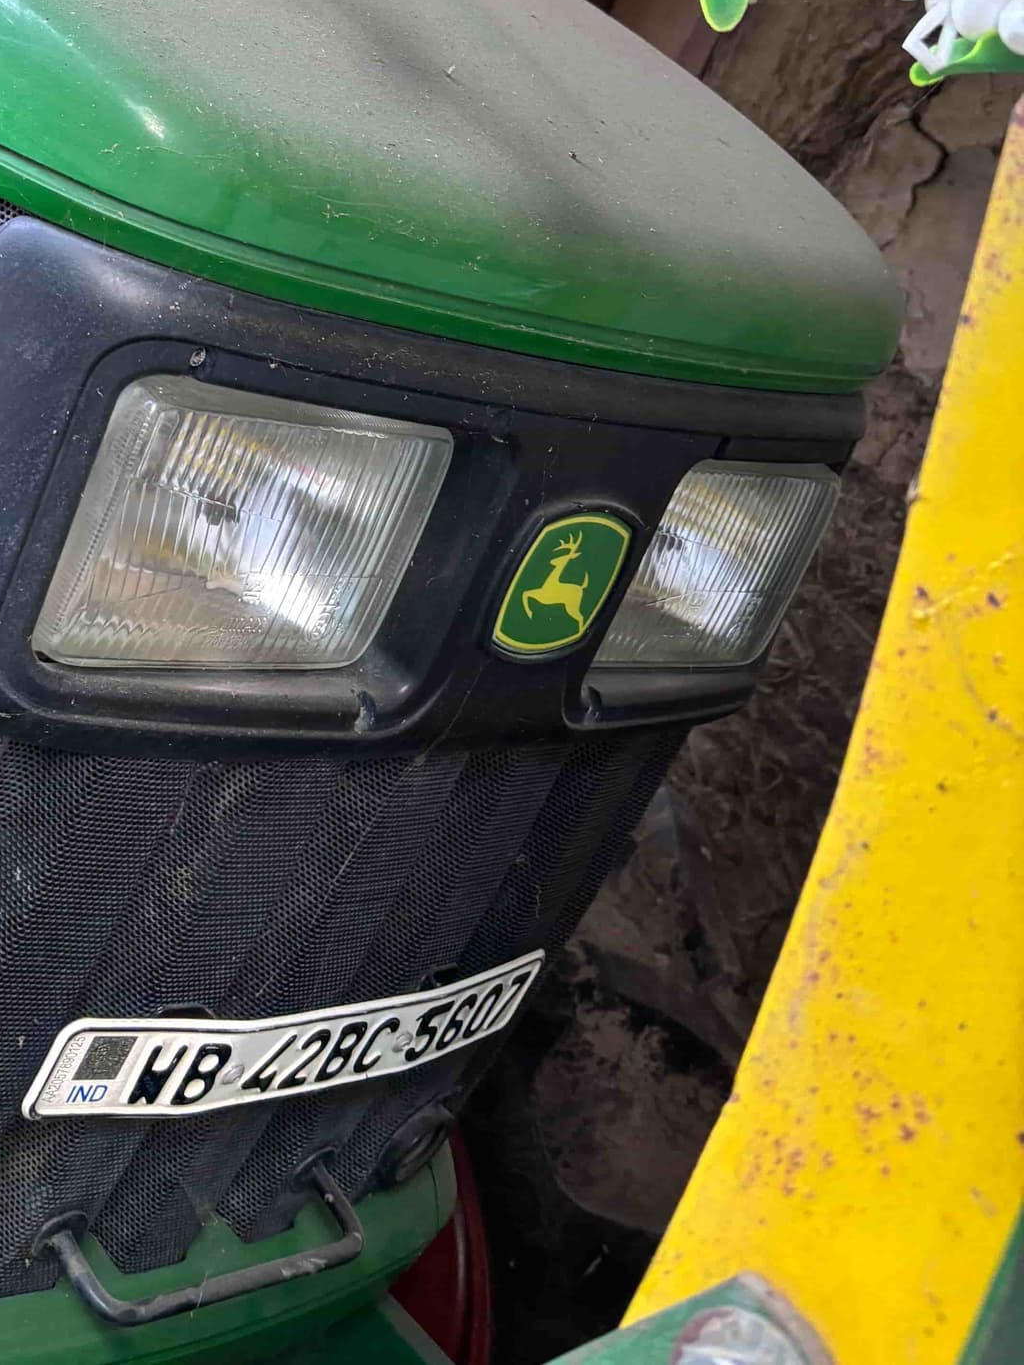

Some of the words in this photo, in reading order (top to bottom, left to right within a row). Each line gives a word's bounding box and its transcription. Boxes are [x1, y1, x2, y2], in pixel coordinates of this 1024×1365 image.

[127, 1043, 232, 1106] WB
[405, 971, 533, 1061] 5607
[65, 1085, 108, 1103] IND
